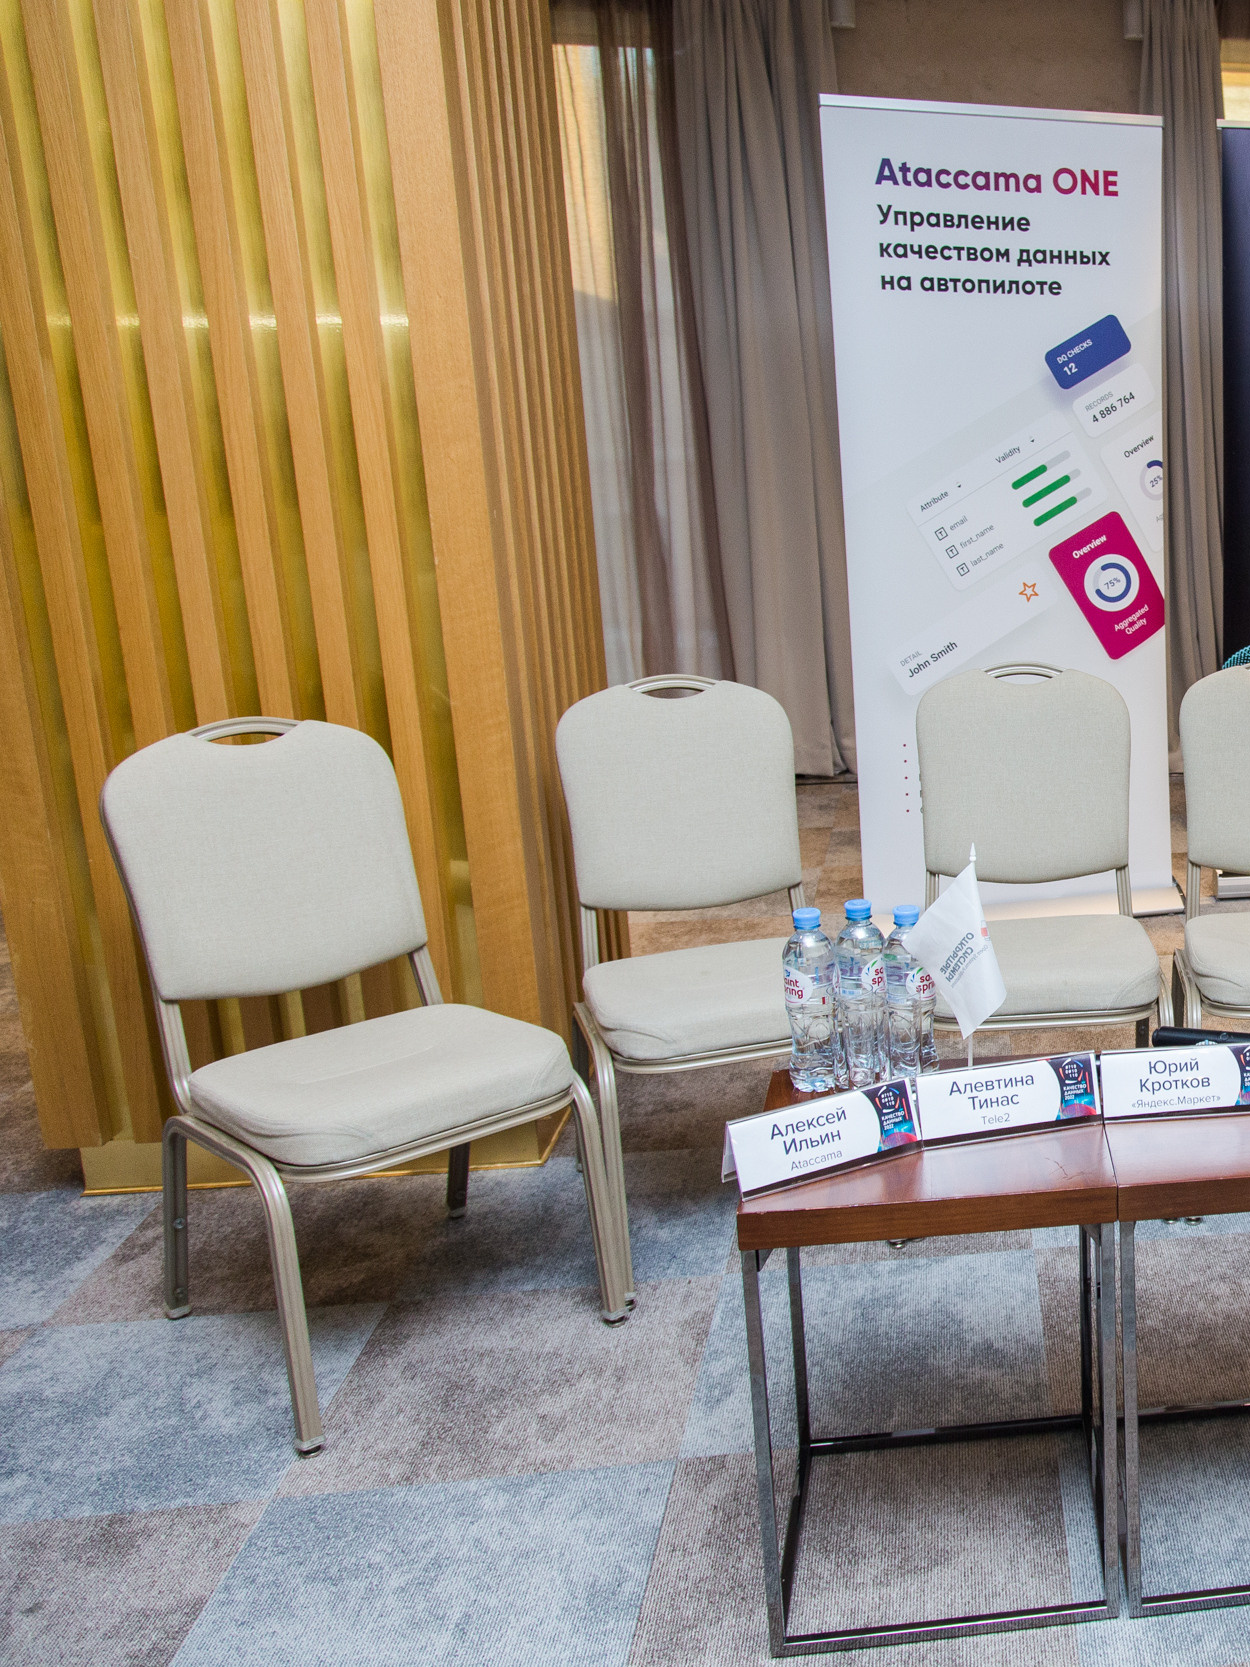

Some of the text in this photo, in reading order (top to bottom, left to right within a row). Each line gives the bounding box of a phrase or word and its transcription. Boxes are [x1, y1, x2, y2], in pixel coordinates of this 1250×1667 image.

[875, 158, 1119, 197] Ataccama ONE
[877, 204, 1030, 232] Управление
[879, 242, 1110, 267] качеством данных
[881, 275, 1062, 295] на автопилоте
[1056, 338, 1093, 364] DQ CHECKS
[1063, 363, 1078, 376] 12
[1085, 391, 1114, 412] RECORDS
[1099, 402, 1118, 420] 886
[1116, 392, 1136, 408] 764
[995, 445, 1021, 464] Validity
[1124, 435, 1154, 458] Overview
[919, 490, 949, 512] Attribute
[949, 515, 968, 531] email
[959, 524, 995, 549] first_name
[1072, 534, 1107, 559] Overview
[970, 542, 1004, 567] last_name
[1104, 577, 1121, 590] 75%
[1114, 604, 1149, 632] Aggregated
[1125, 617, 1147, 635] Quality
[900, 650, 922, 667] DETAIL
[908, 640, 958, 678] John Smith
[784, 976, 800, 989] aint
[1149, 1058, 1199, 1076] Юрий
[949, 1074, 1035, 1096] Алевтина
[1063, 1083, 1087, 1091] КАЧЕСТВО
[1140, 1077, 1211, 1095] Кротков
[968, 1093, 1020, 1111] Тинас
[1131, 1095, 1221, 1109] «Яндекс.Маркет»
[770, 1107, 847, 1140] Алексей
[881, 1110, 905, 1121] КАЧЕСТВО
[981, 1113, 1010, 1125] Tele2
[783, 1130, 842, 1155] Ильин
[790, 1150, 843, 1171] Ataccama
